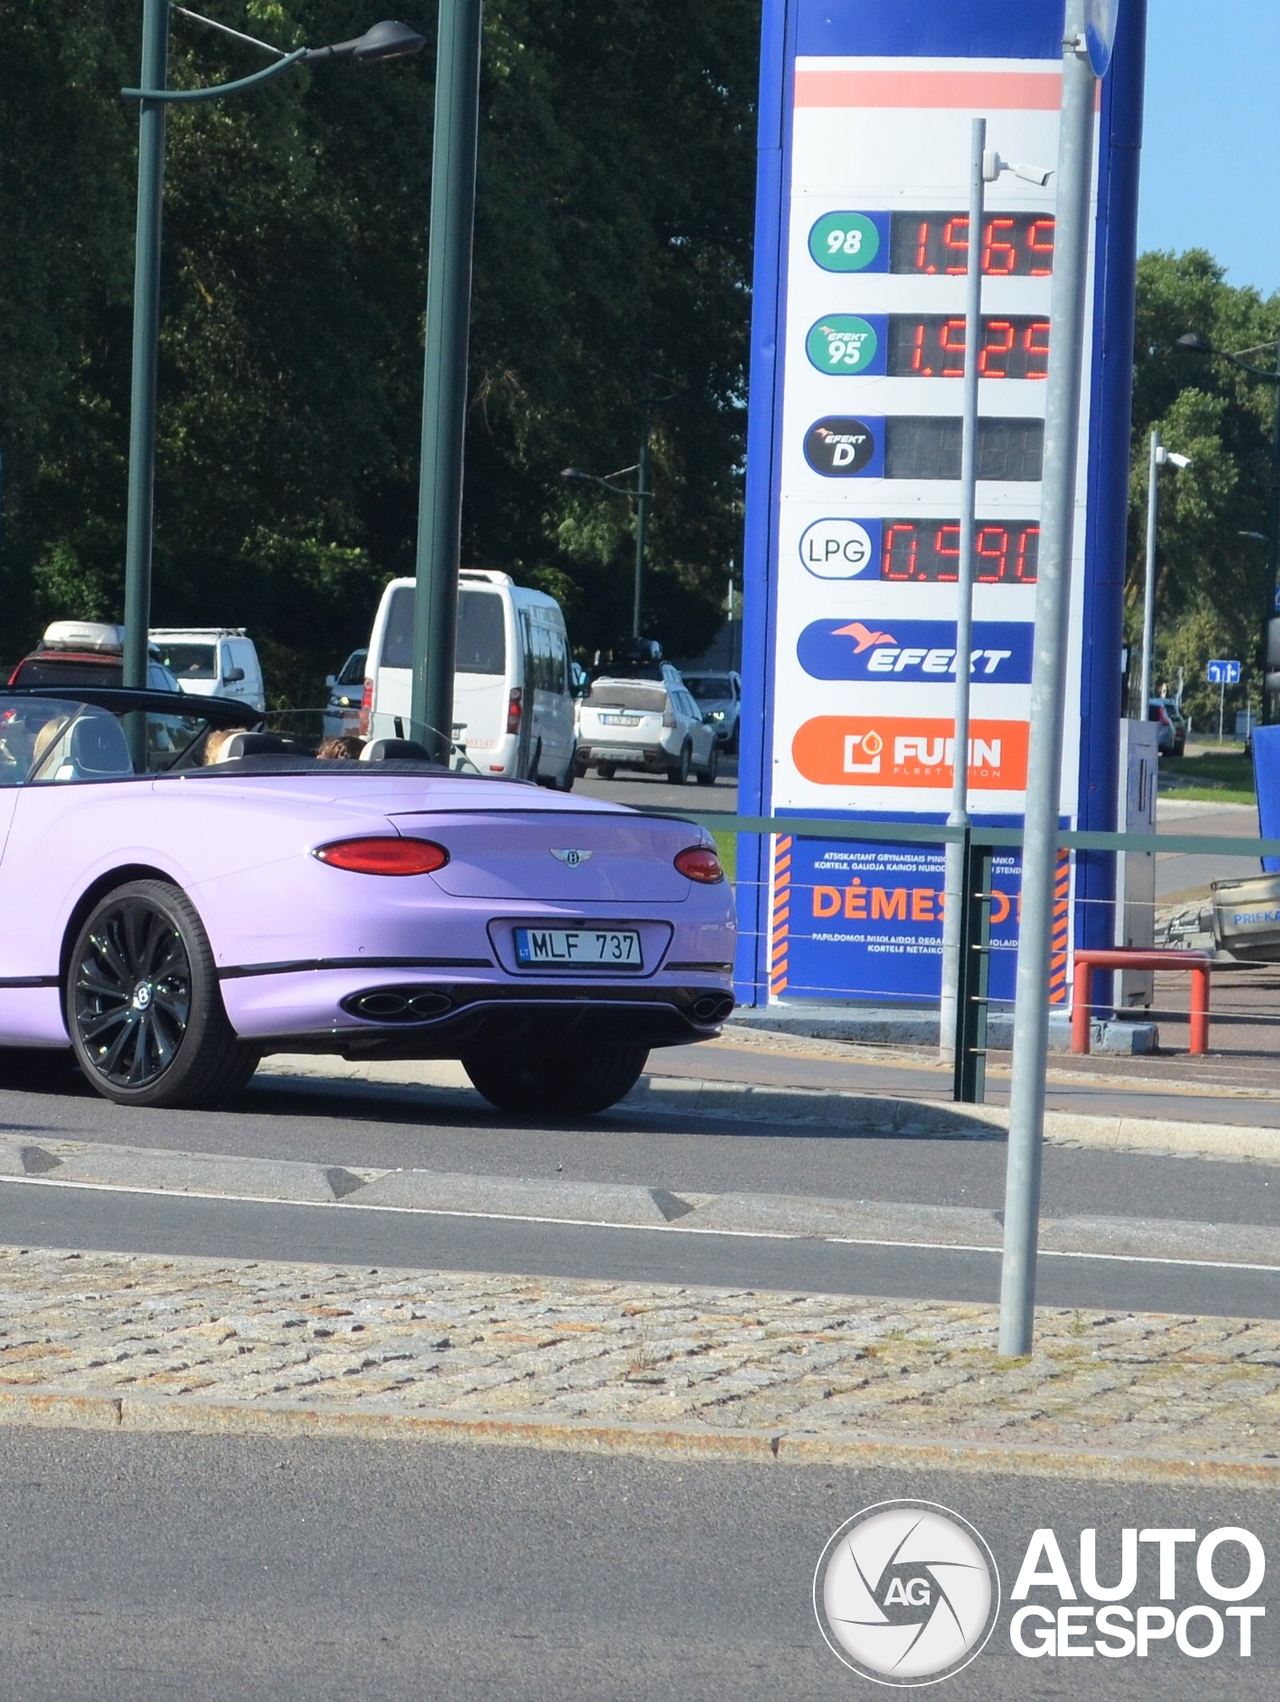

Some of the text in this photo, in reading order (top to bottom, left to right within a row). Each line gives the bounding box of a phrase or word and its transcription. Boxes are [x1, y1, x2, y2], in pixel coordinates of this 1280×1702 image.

[827, 230, 862, 254] 98
[827, 332, 868, 341] EFEKT
[829, 341, 861, 364] 95
[824, 434, 866, 443] EFEKT
[832, 443, 855, 466] D
[809, 538, 865, 562] LPG
[894, 767, 942, 775] FLEET
[532, 932, 579, 958] MLF
[595, 934, 634, 960] 737
